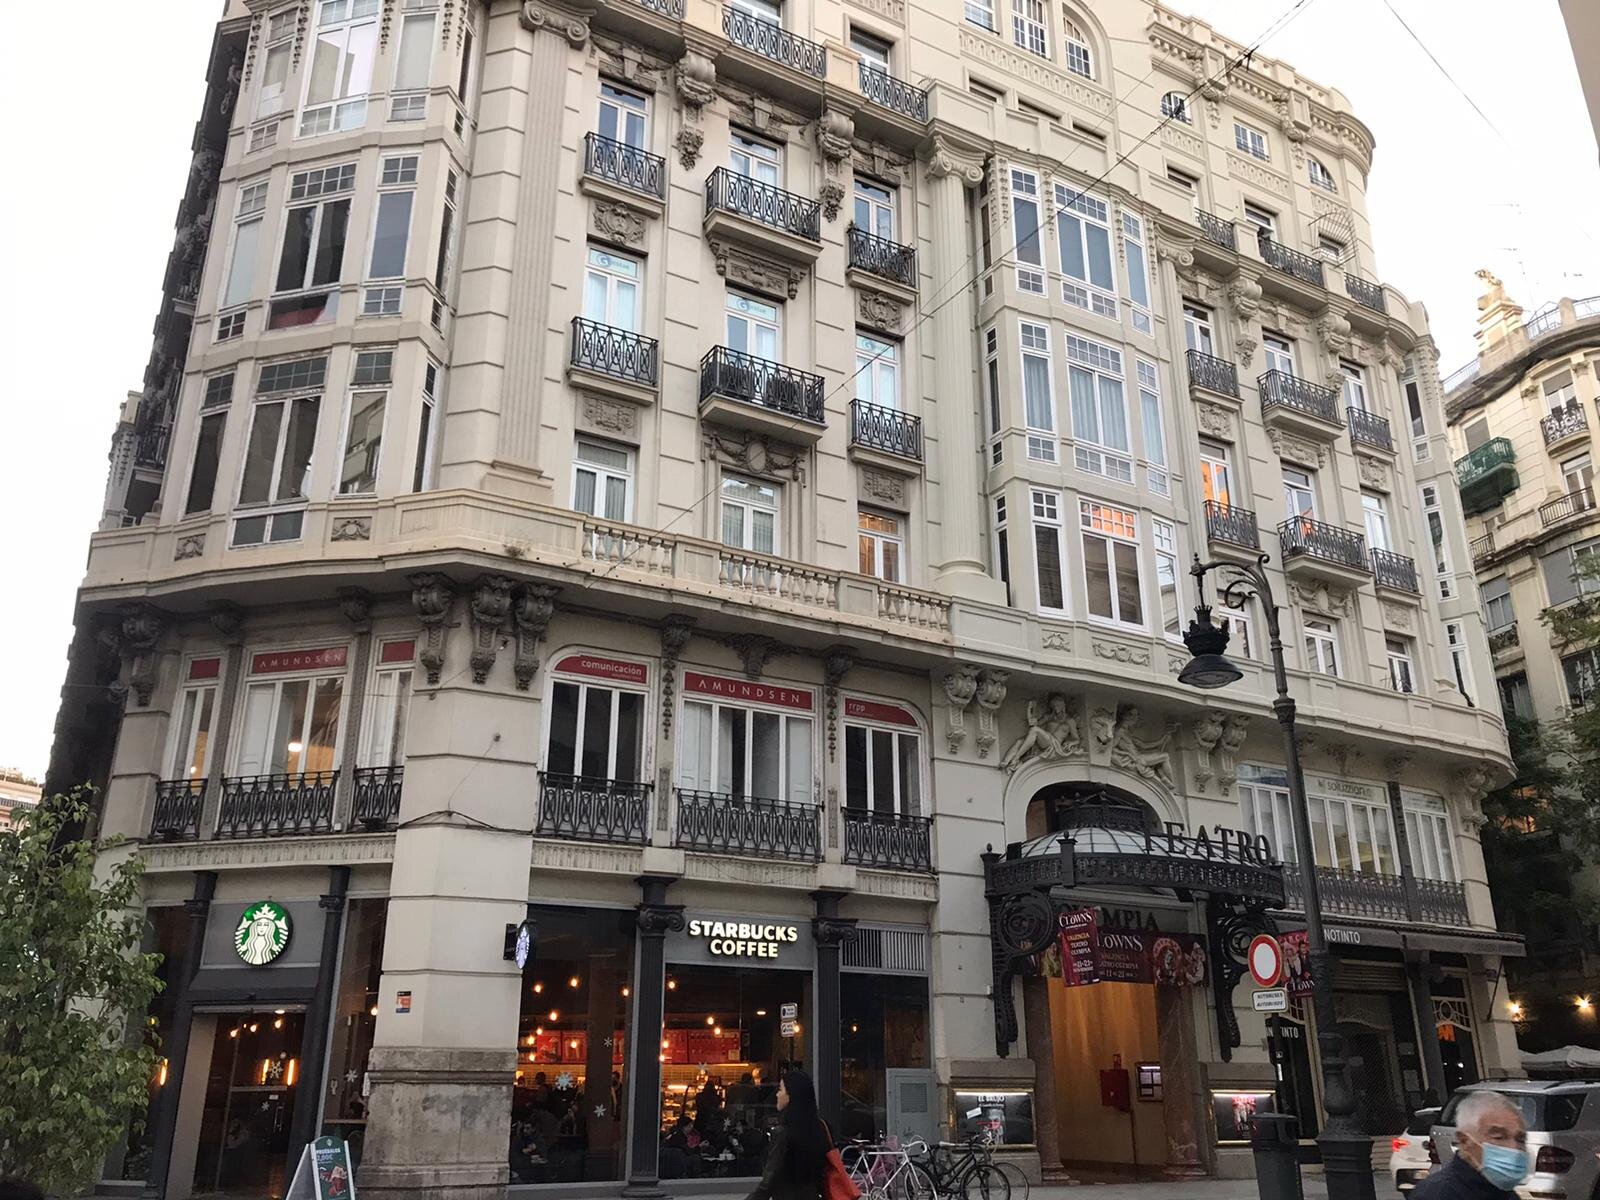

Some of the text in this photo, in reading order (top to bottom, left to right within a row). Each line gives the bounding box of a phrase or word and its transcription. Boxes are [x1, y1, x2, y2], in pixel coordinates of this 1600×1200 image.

[259, 654, 342, 669] AMUNDSEN
[580, 660, 642, 676] comunicación
[698, 680, 800, 703] AMUNDSEN
[1139, 821, 1273, 866] TEATRO
[1059, 911, 1093, 928] CLOWNS
[689, 919, 798, 942] STARBUCKS
[709, 938, 779, 958] COFFEE
